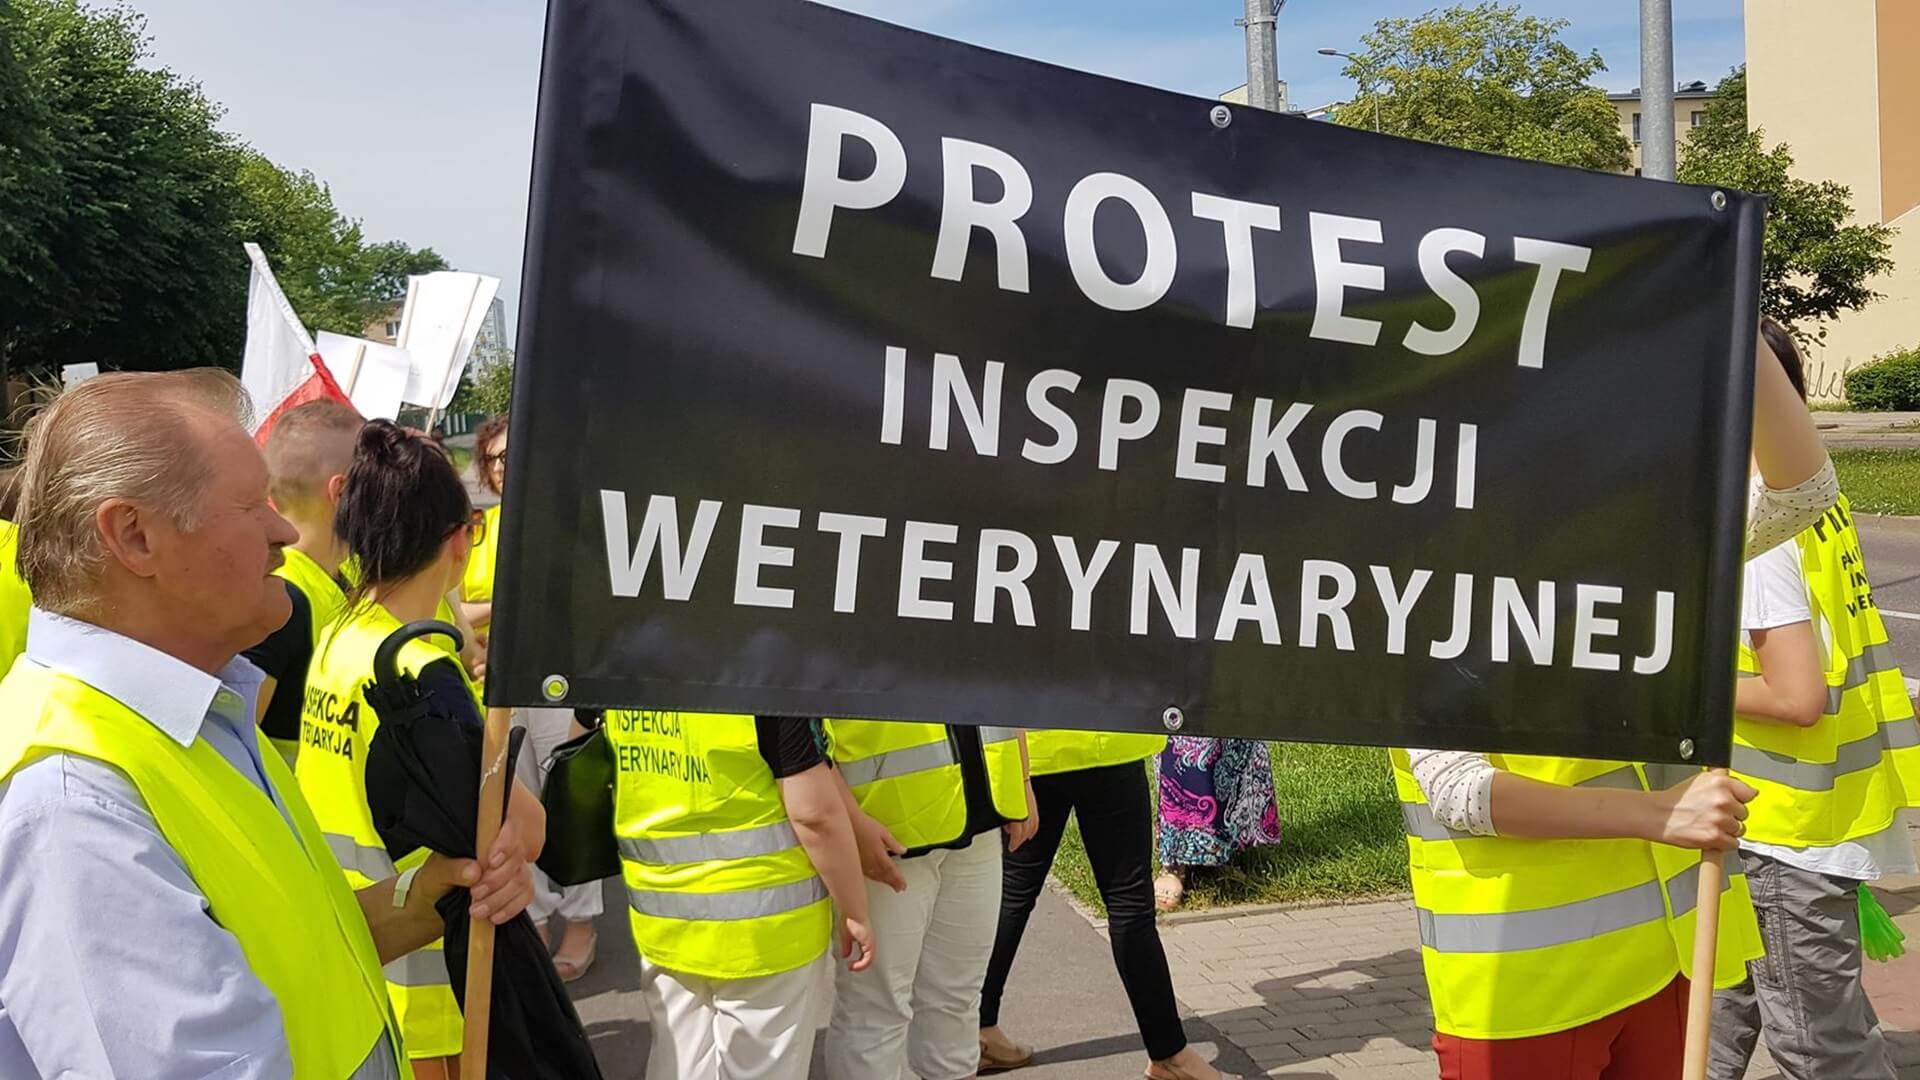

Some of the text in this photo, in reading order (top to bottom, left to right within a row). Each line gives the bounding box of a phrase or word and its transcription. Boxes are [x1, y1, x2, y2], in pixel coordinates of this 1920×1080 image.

[793, 103, 1591, 368] PROTEST
[881, 346, 1477, 509] INSPEKCJI
[601, 490, 1674, 674] WETERYNARYJNEJ
[616, 743, 712, 784] ERYNARYJNA
